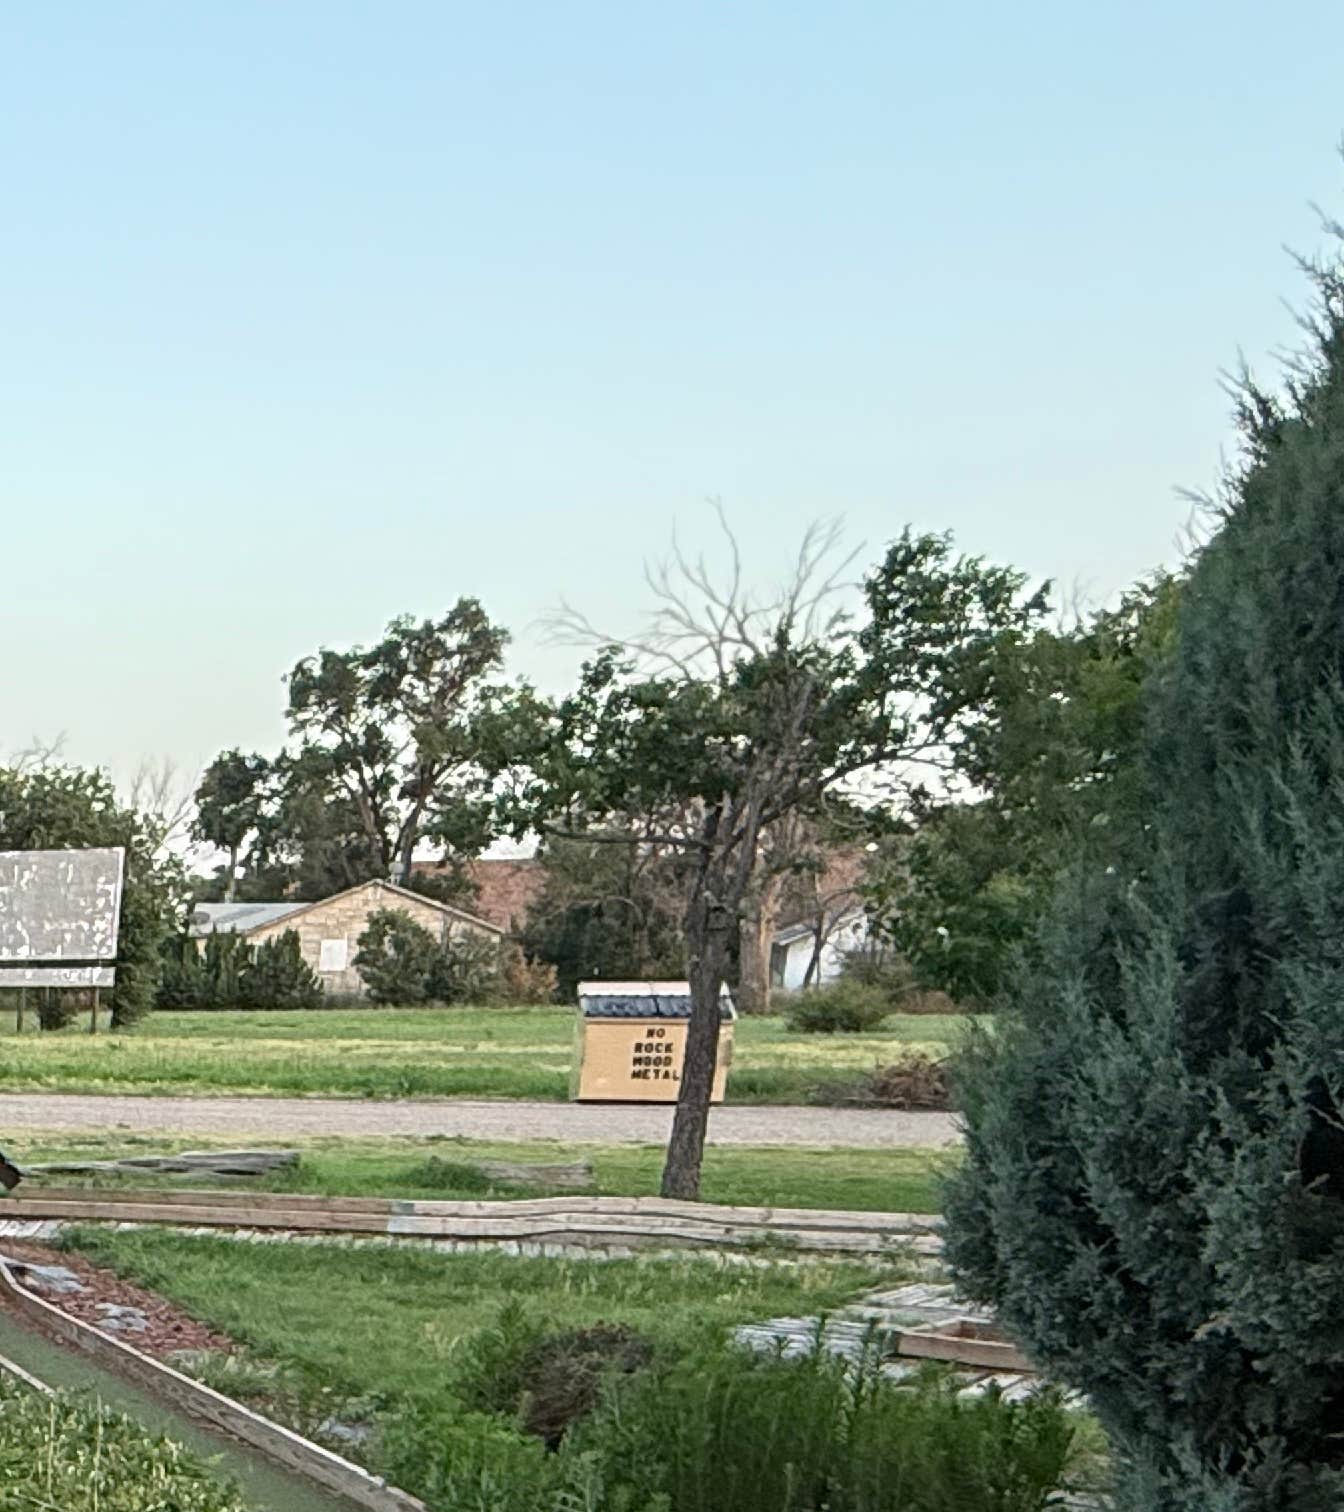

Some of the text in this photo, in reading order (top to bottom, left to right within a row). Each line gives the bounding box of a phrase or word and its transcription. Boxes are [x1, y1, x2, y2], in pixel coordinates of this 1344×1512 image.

[646, 1028, 666, 1038] NO
[634, 1042, 674, 1053] ROCK
[630, 1068, 680, 1081] METAL
